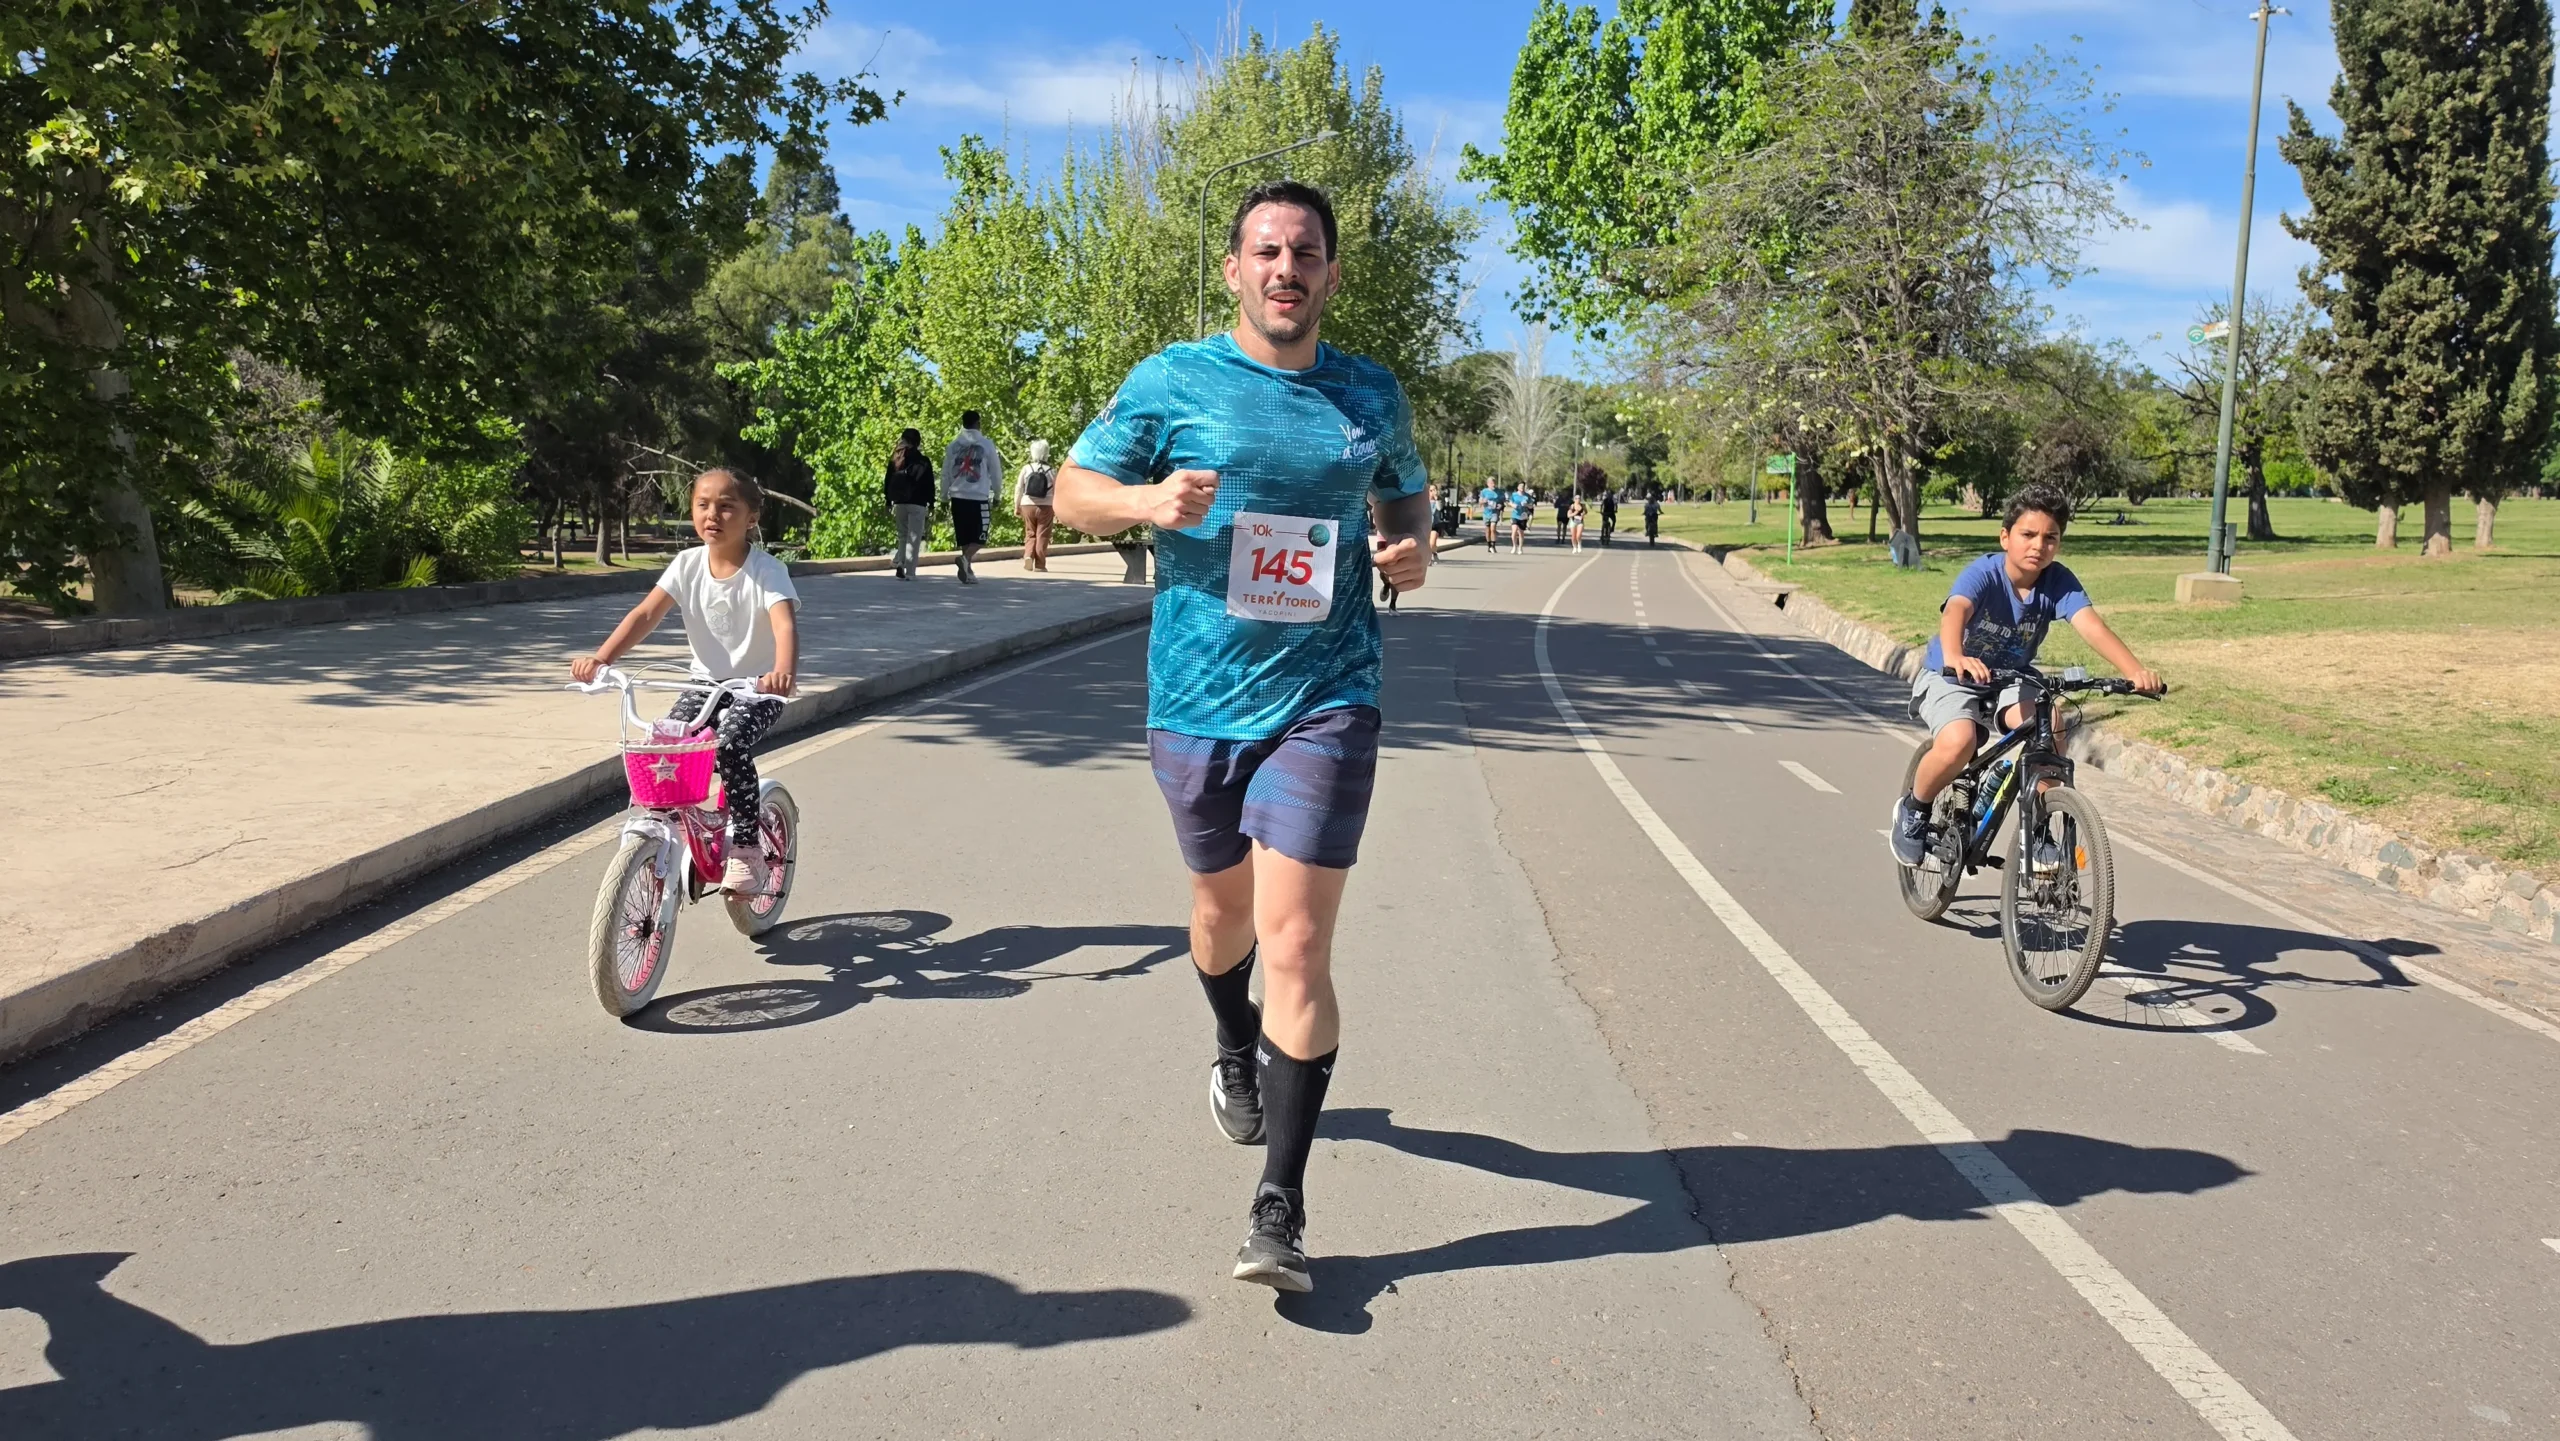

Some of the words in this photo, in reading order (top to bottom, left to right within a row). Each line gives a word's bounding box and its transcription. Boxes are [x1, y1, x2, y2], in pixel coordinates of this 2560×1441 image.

[1252, 524, 1273, 537] 10k
[1251, 547, 1313, 585] 145
[1243, 590, 1320, 608] TERRITORIO
[2000, 626, 2011, 638] TO
